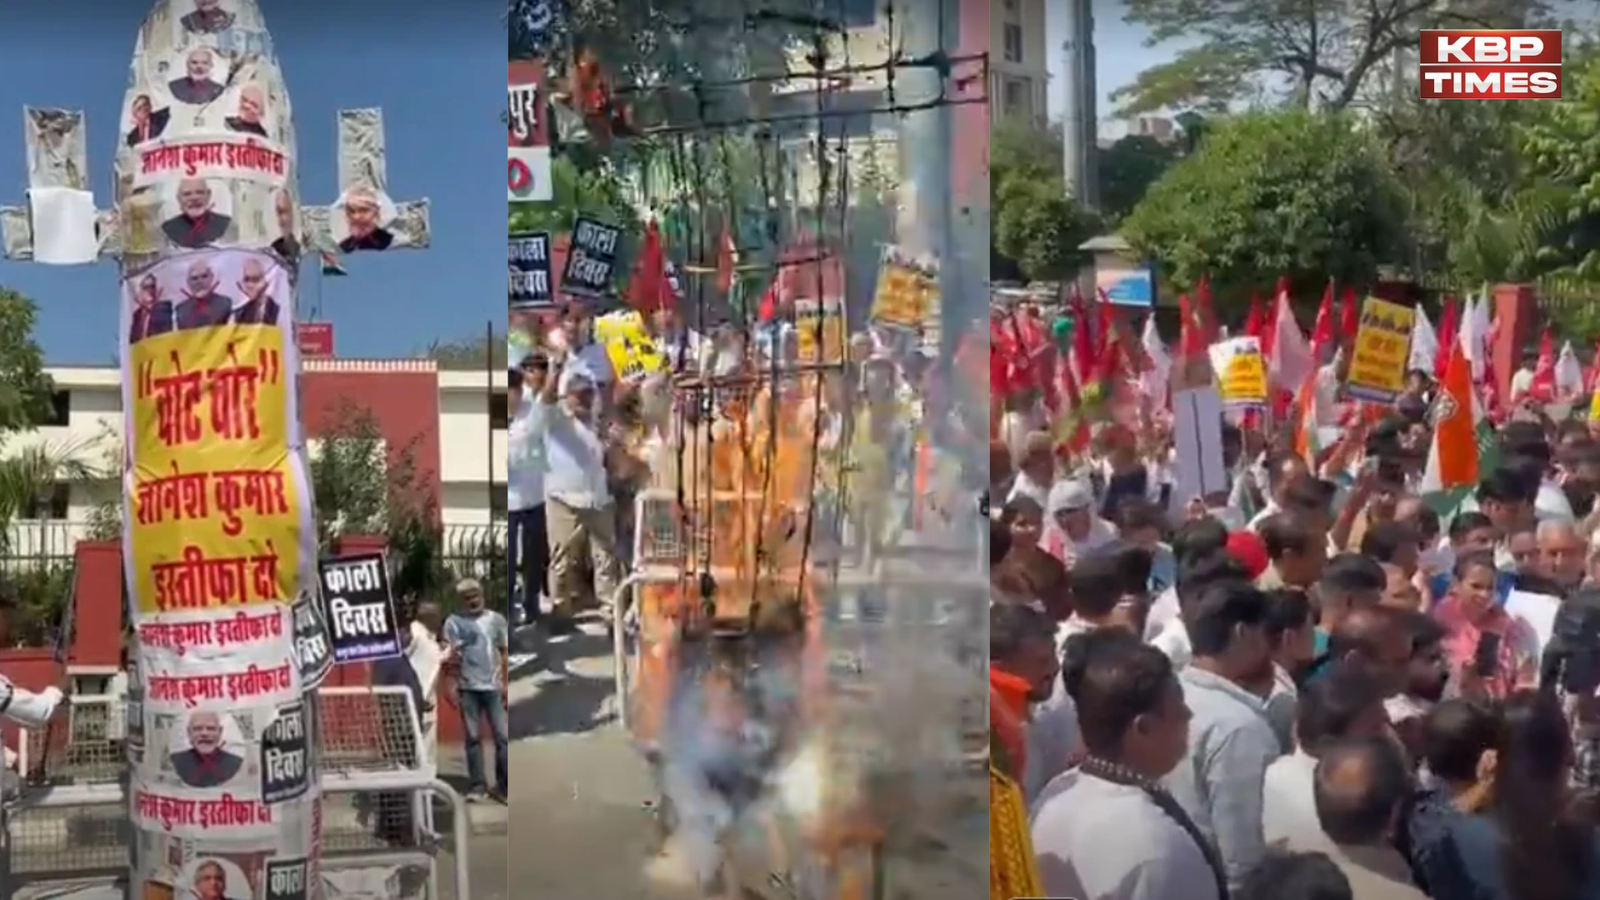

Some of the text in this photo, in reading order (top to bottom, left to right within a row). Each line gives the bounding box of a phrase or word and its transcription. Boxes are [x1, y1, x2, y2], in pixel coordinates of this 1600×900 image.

[182, 142, 223, 176] कुमार
[137, 459, 288, 536] ज्ञानेश कुमार
[152, 539, 278, 611] इस्तीफा दो
[323, 559, 381, 593] काला
[171, 621, 212, 656] कुमार
[215, 611, 269, 647] इस्तीफा
[270, 605, 282, 636] दो
[330, 597, 388, 639] दिवस
[181, 674, 223, 708] कुमार
[227, 663, 278, 701] इस्तीफा
[278, 658, 291, 688] दो
[158, 796, 195, 831] कुमार
[199, 792, 254, 829] इस्तीफा
